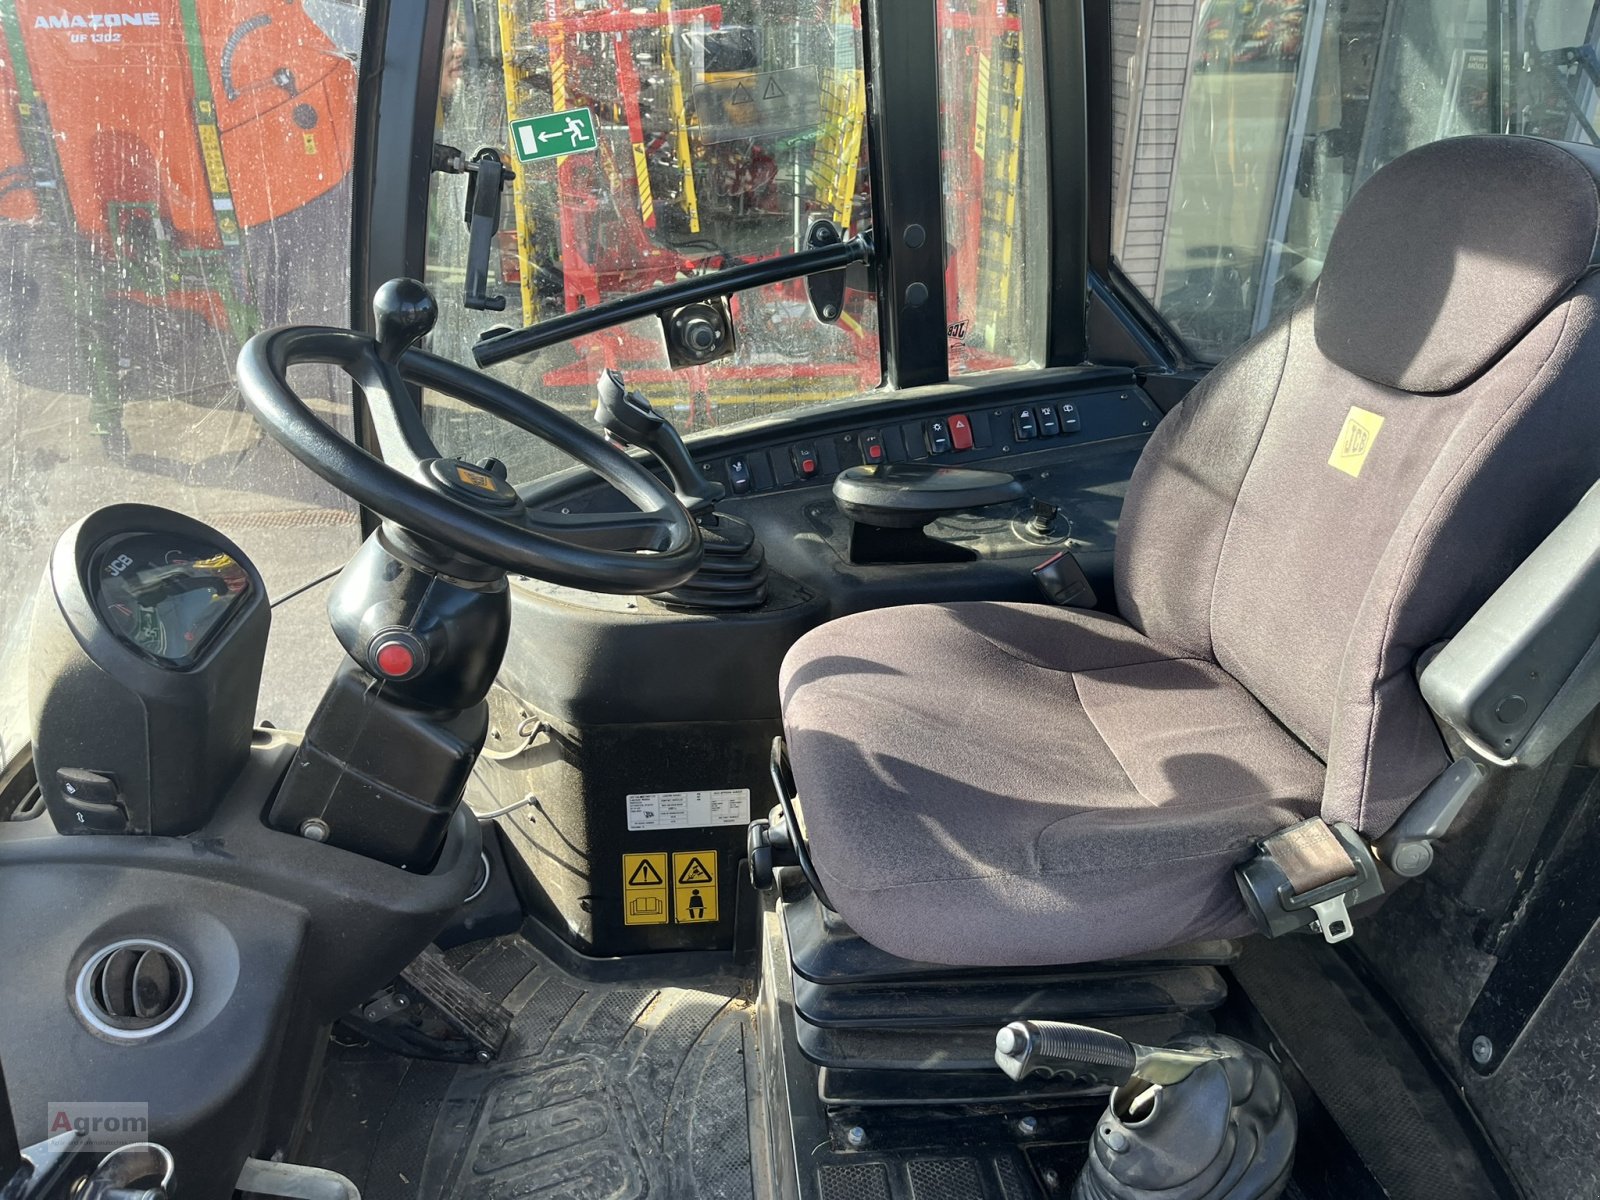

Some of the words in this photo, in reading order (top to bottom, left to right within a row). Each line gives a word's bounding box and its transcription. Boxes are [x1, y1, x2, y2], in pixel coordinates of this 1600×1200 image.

[35, 12, 160, 29] AMAZONE
[70, 33, 88, 42] UF
[90, 33, 121, 42] 1302
[109, 553, 134, 577] JCB
